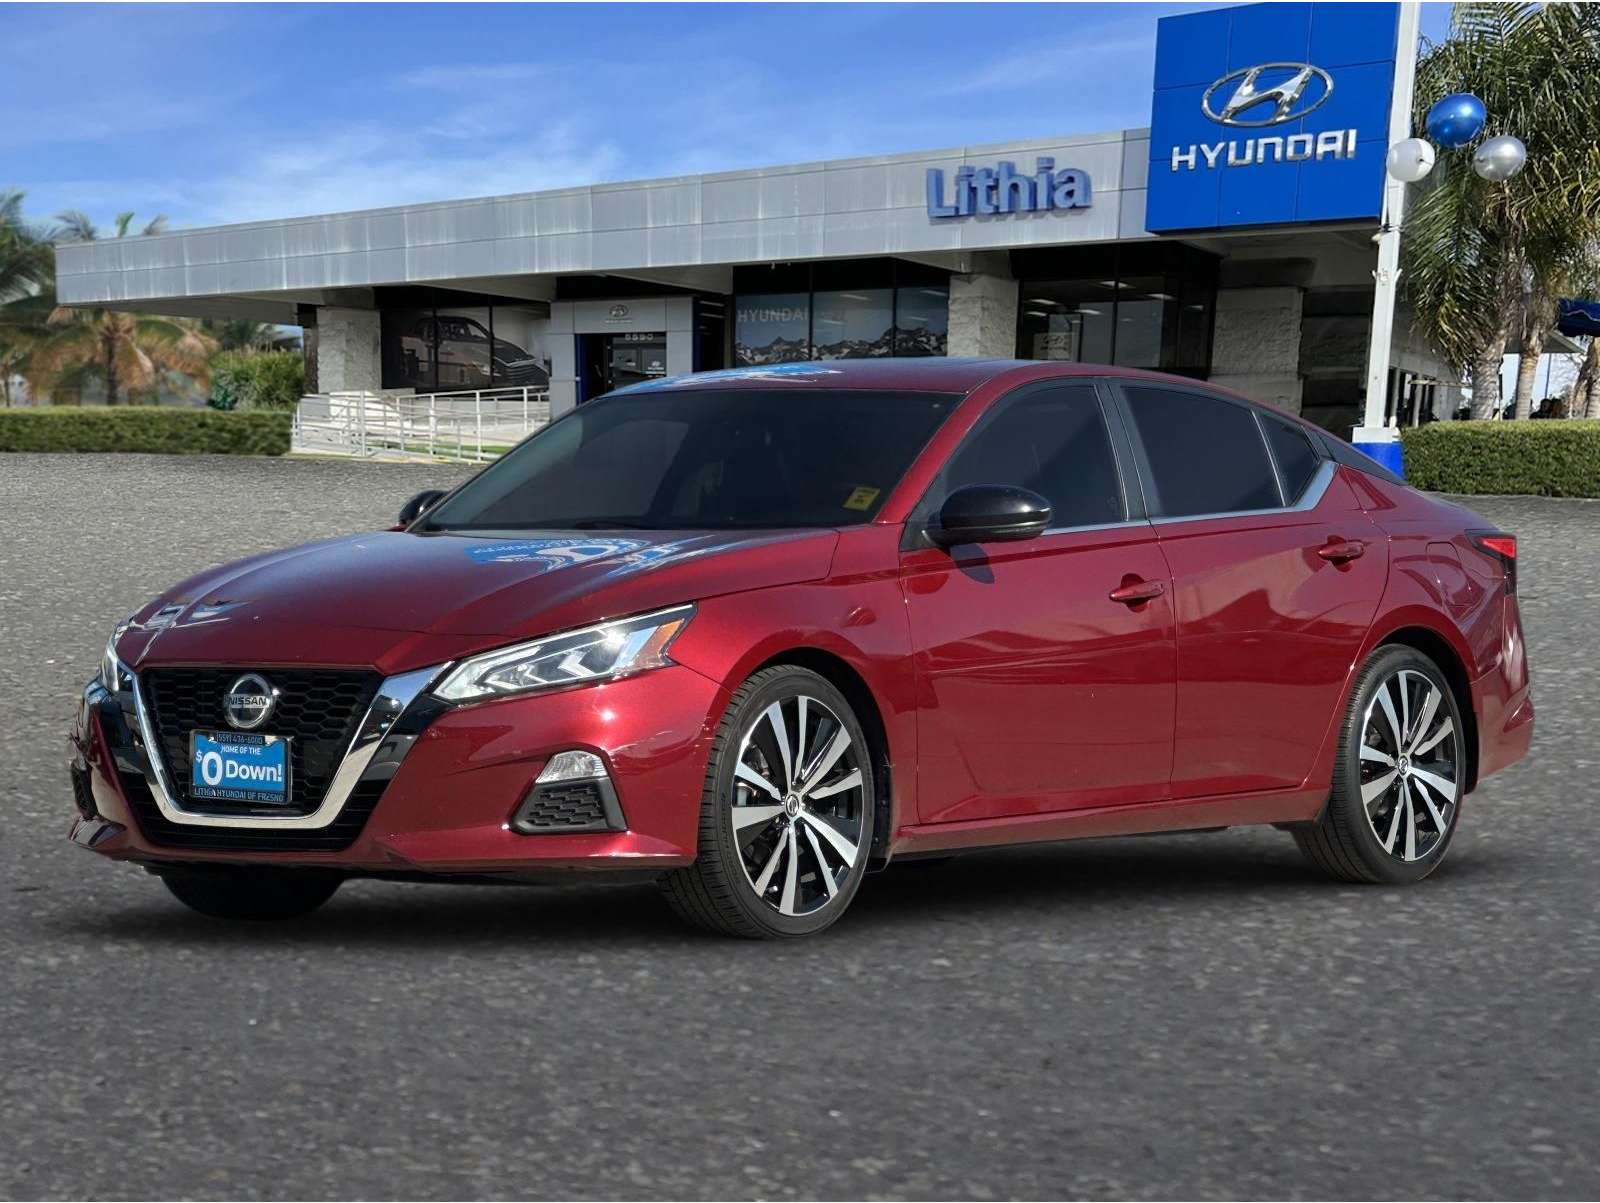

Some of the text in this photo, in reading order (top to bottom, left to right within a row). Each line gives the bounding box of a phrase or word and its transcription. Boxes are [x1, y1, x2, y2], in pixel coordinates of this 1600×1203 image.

[1171, 128, 1357, 172] HYUNDAI
[926, 156, 1092, 218] Lithia
[737, 307, 808, 323] HYUNDAI
[230, 696, 267, 706] NISSAN
[221, 744, 262, 755] HOME OF THE
[226, 760, 282, 782] Down!
[194, 787, 284, 802] LITHIA HYUNDAI OF FRESNO
